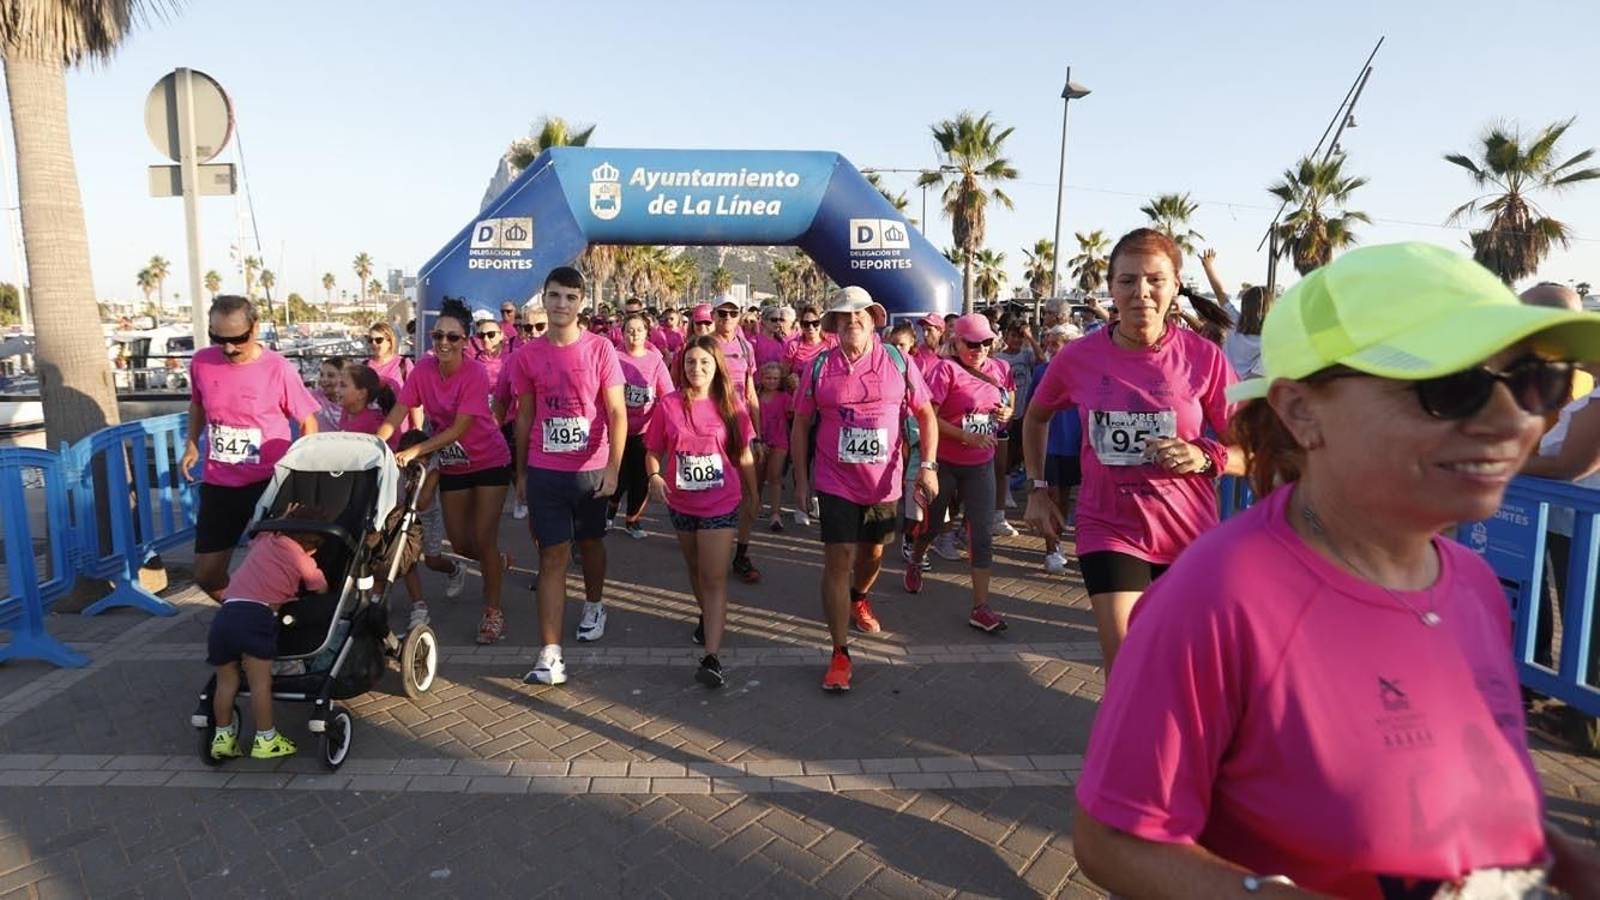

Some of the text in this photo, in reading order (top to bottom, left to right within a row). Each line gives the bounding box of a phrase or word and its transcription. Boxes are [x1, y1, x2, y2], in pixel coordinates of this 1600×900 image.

[629, 167, 800, 191] Ayuntamiento
[648, 194, 781, 216] de La Línea
[478, 226, 494, 242] D
[857, 226, 874, 244] D
[469, 259, 533, 269] DEPORTES
[850, 258, 912, 270] DEPORTES
[549, 427, 582, 444] 495
[1111, 429, 1151, 452] 95
[214, 437, 251, 455] 647
[846, 438, 880, 456] 449
[683, 465, 715, 482] 508
